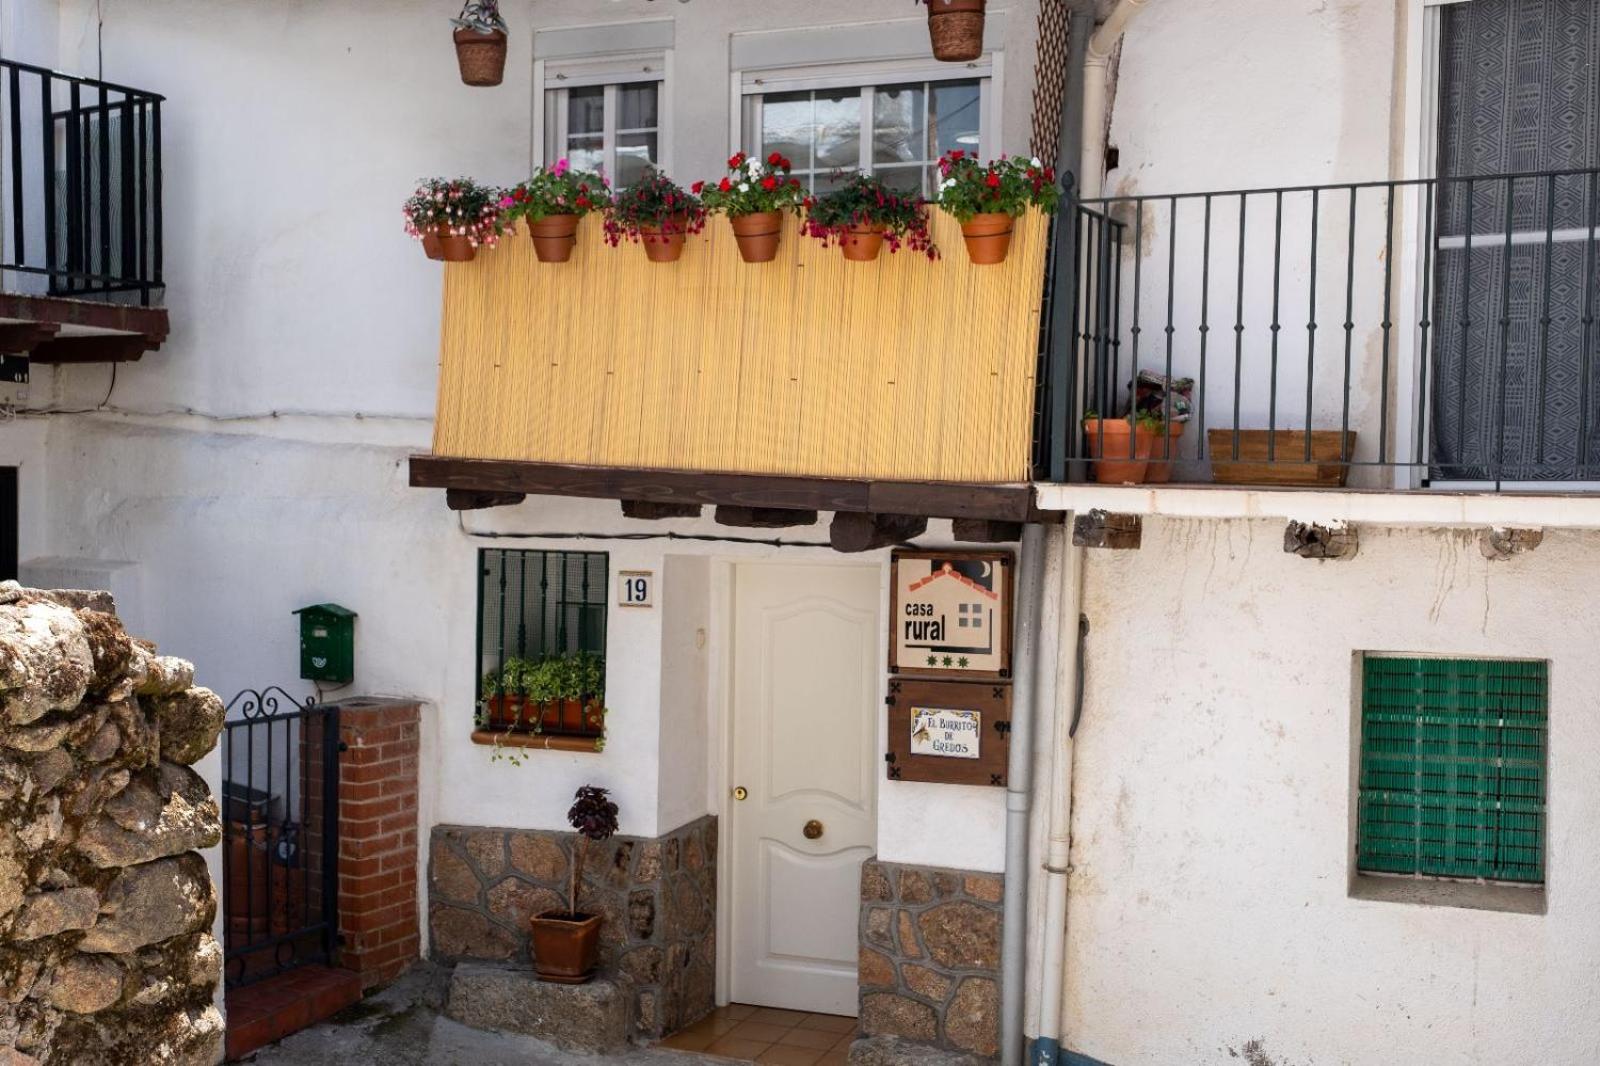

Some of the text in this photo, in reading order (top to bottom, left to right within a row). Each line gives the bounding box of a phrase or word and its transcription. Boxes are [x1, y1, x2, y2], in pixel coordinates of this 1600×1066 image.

[625, 578, 647, 602] 19
[905, 603, 934, 616] casa
[905, 614, 945, 641] rural
[940, 718, 972, 731] BURRITO
[944, 731, 953, 741] DE
[932, 740, 969, 753] GREDOS
